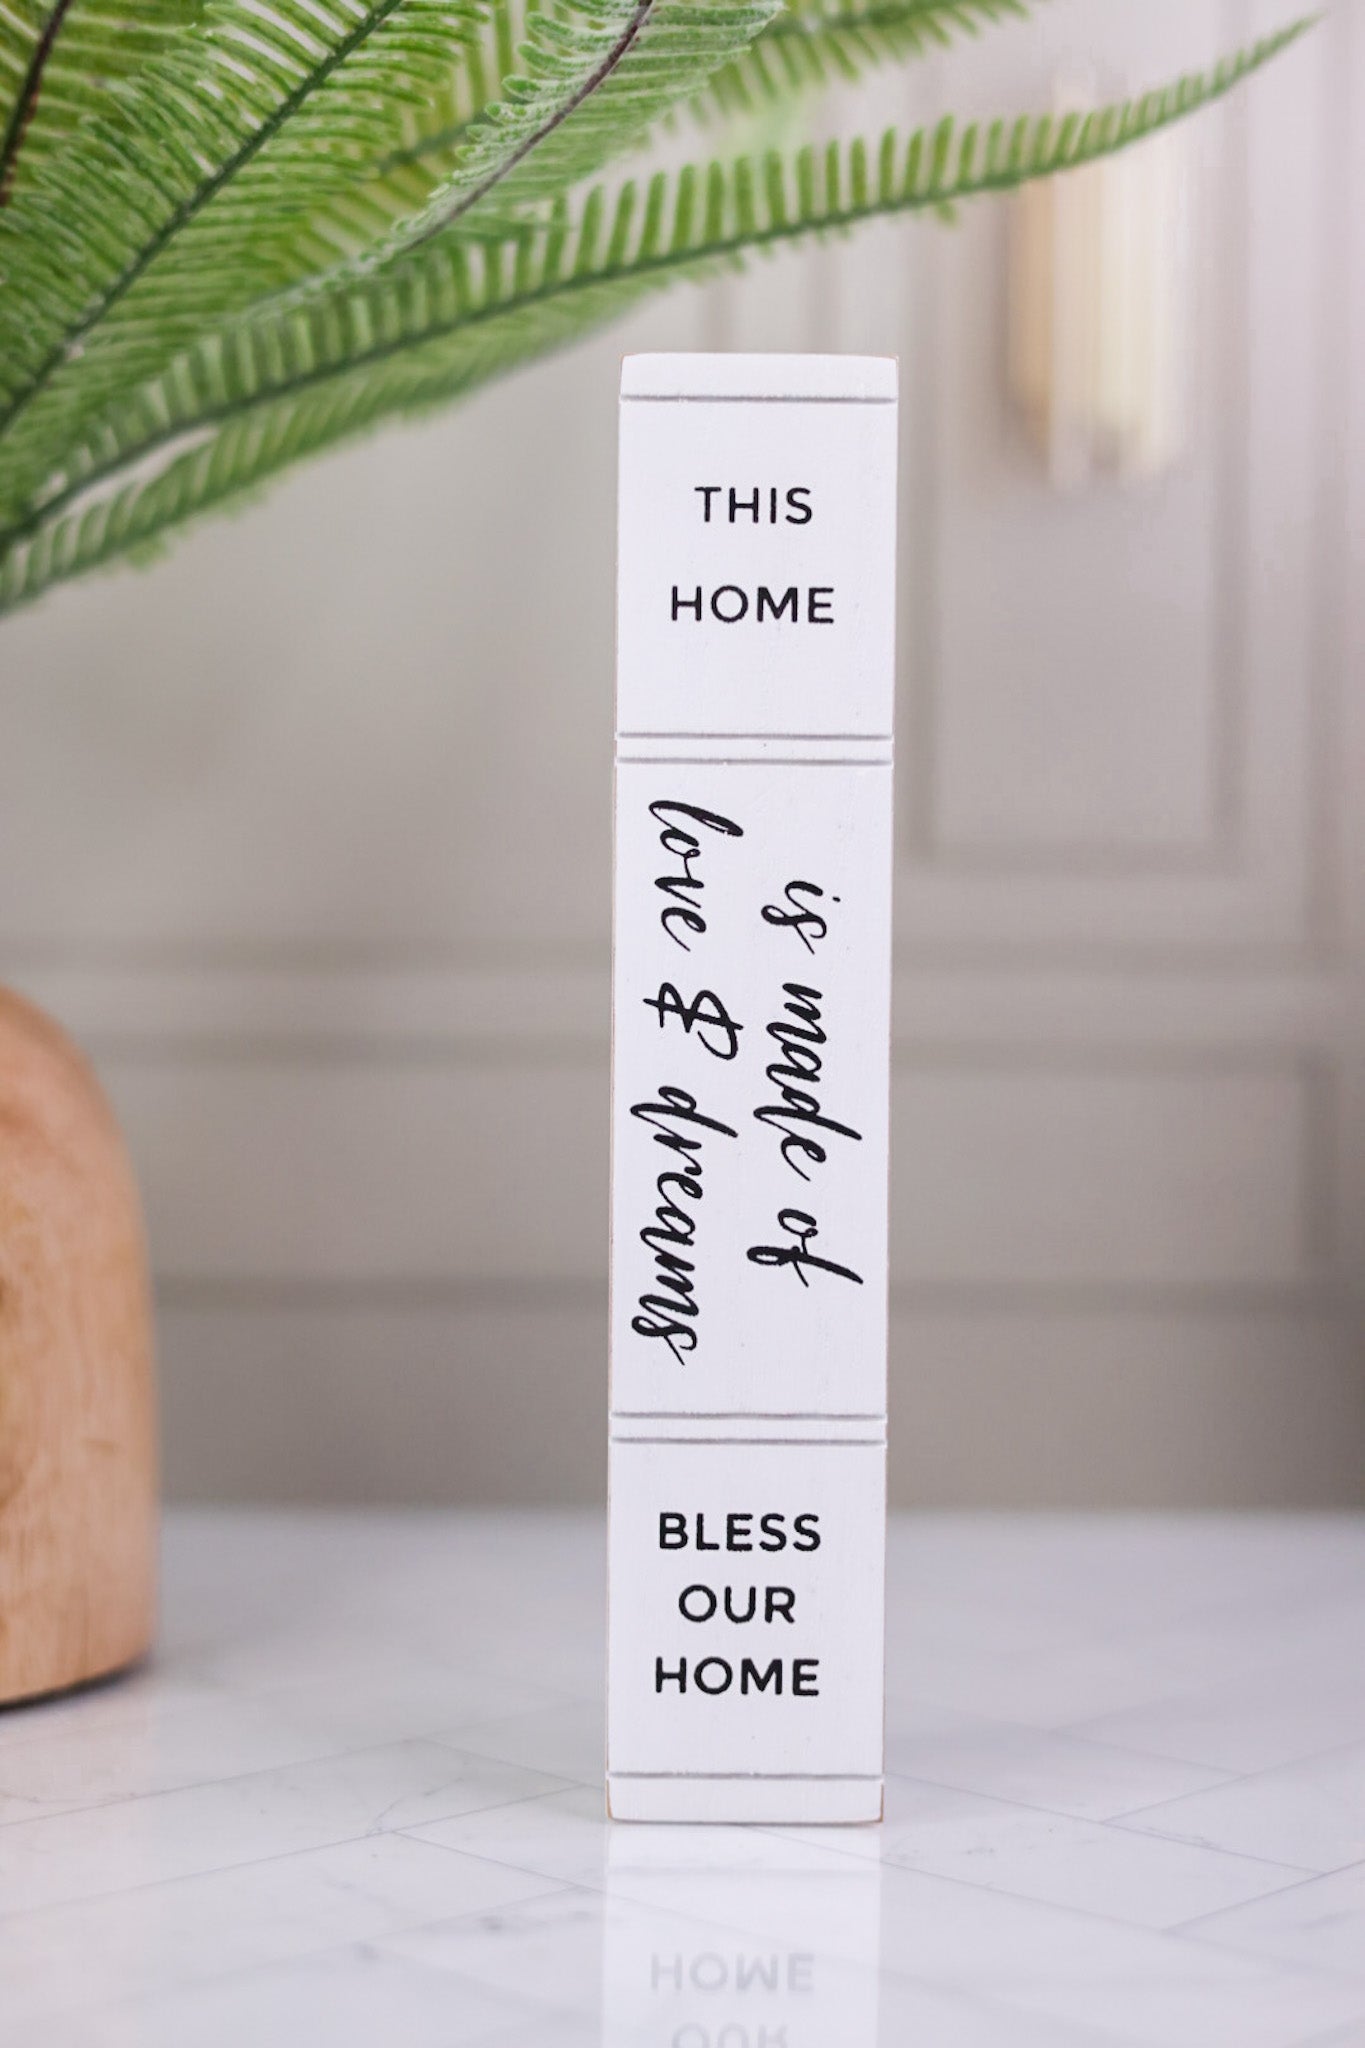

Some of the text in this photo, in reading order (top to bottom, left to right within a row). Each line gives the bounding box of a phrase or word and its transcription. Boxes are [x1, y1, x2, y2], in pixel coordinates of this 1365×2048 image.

[694, 486, 813, 525] THIS
[671, 585, 835, 624] HOME
[629, 800, 744, 1366] love & dreams
[746, 880, 864, 1288] is made of
[659, 1512, 821, 1553] BLESS
[678, 1584, 796, 1624] OUR
[655, 1656, 820, 1697] HOME
